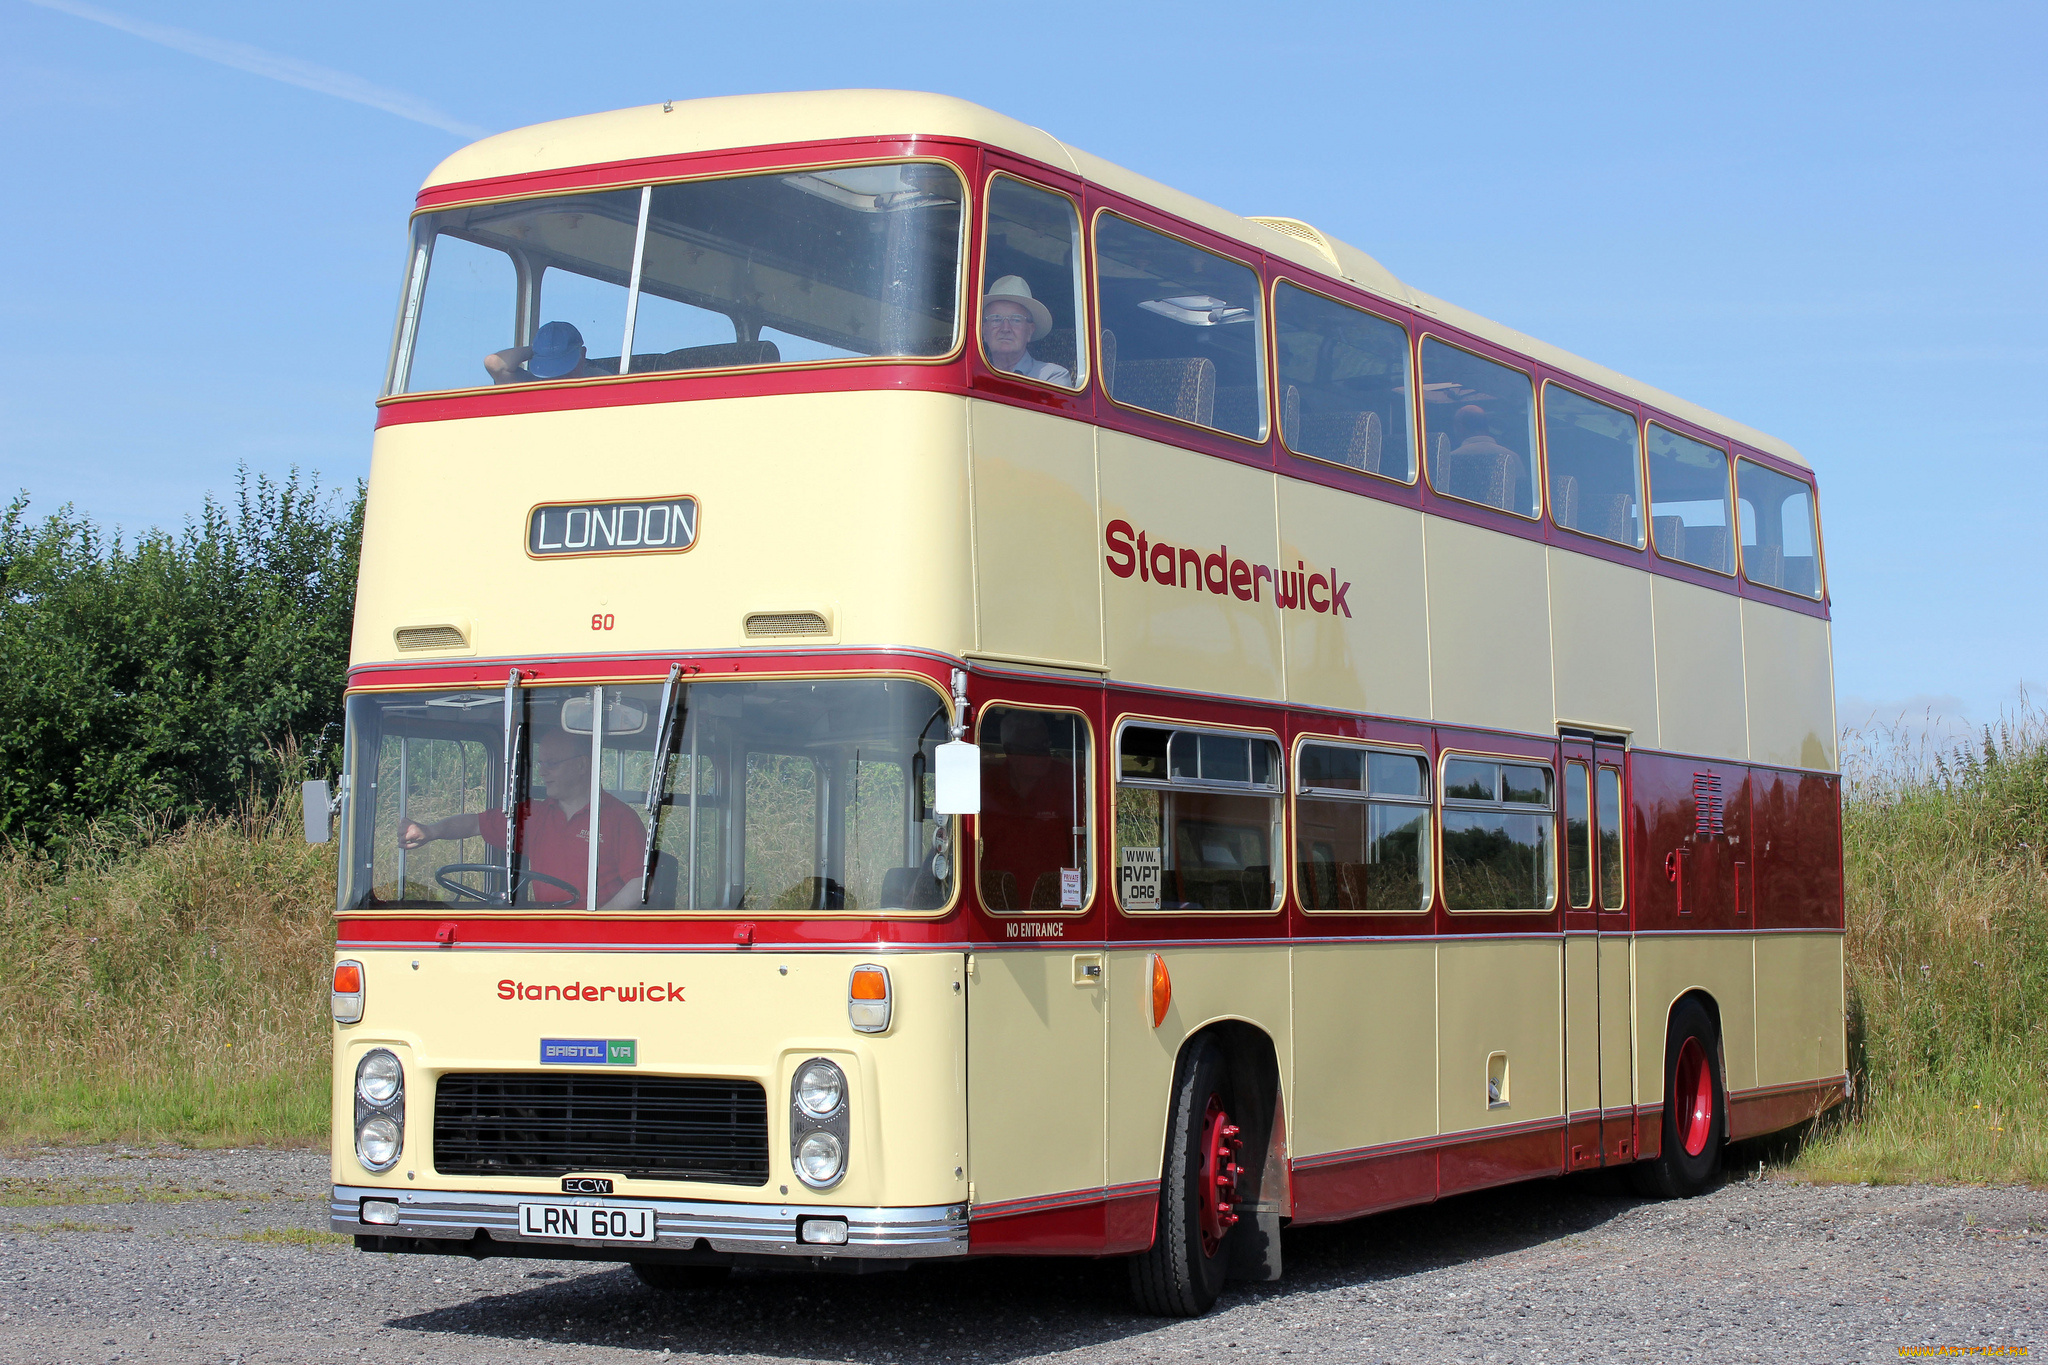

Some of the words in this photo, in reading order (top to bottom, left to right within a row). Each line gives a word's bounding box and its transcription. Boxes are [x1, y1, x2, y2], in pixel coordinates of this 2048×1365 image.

[538, 504, 697, 549] LONDON
[1105, 519, 1353, 619] Standerwick
[591, 614, 615, 631] 60
[1126, 850, 1156, 863] WWW.
[1123, 865, 1159, 882] RVPT
[1128, 885, 1155, 899] .ORG
[1006, 923, 1019, 938] NO
[1020, 922, 1064, 938] ENTRANCE
[497, 979, 686, 1002] Standerwick
[545, 1045, 604, 1057] BRISTOL
[566, 1179, 609, 1193] ECW
[526, 1207, 578, 1235] LRN
[591, 1210, 646, 1238] 60J
